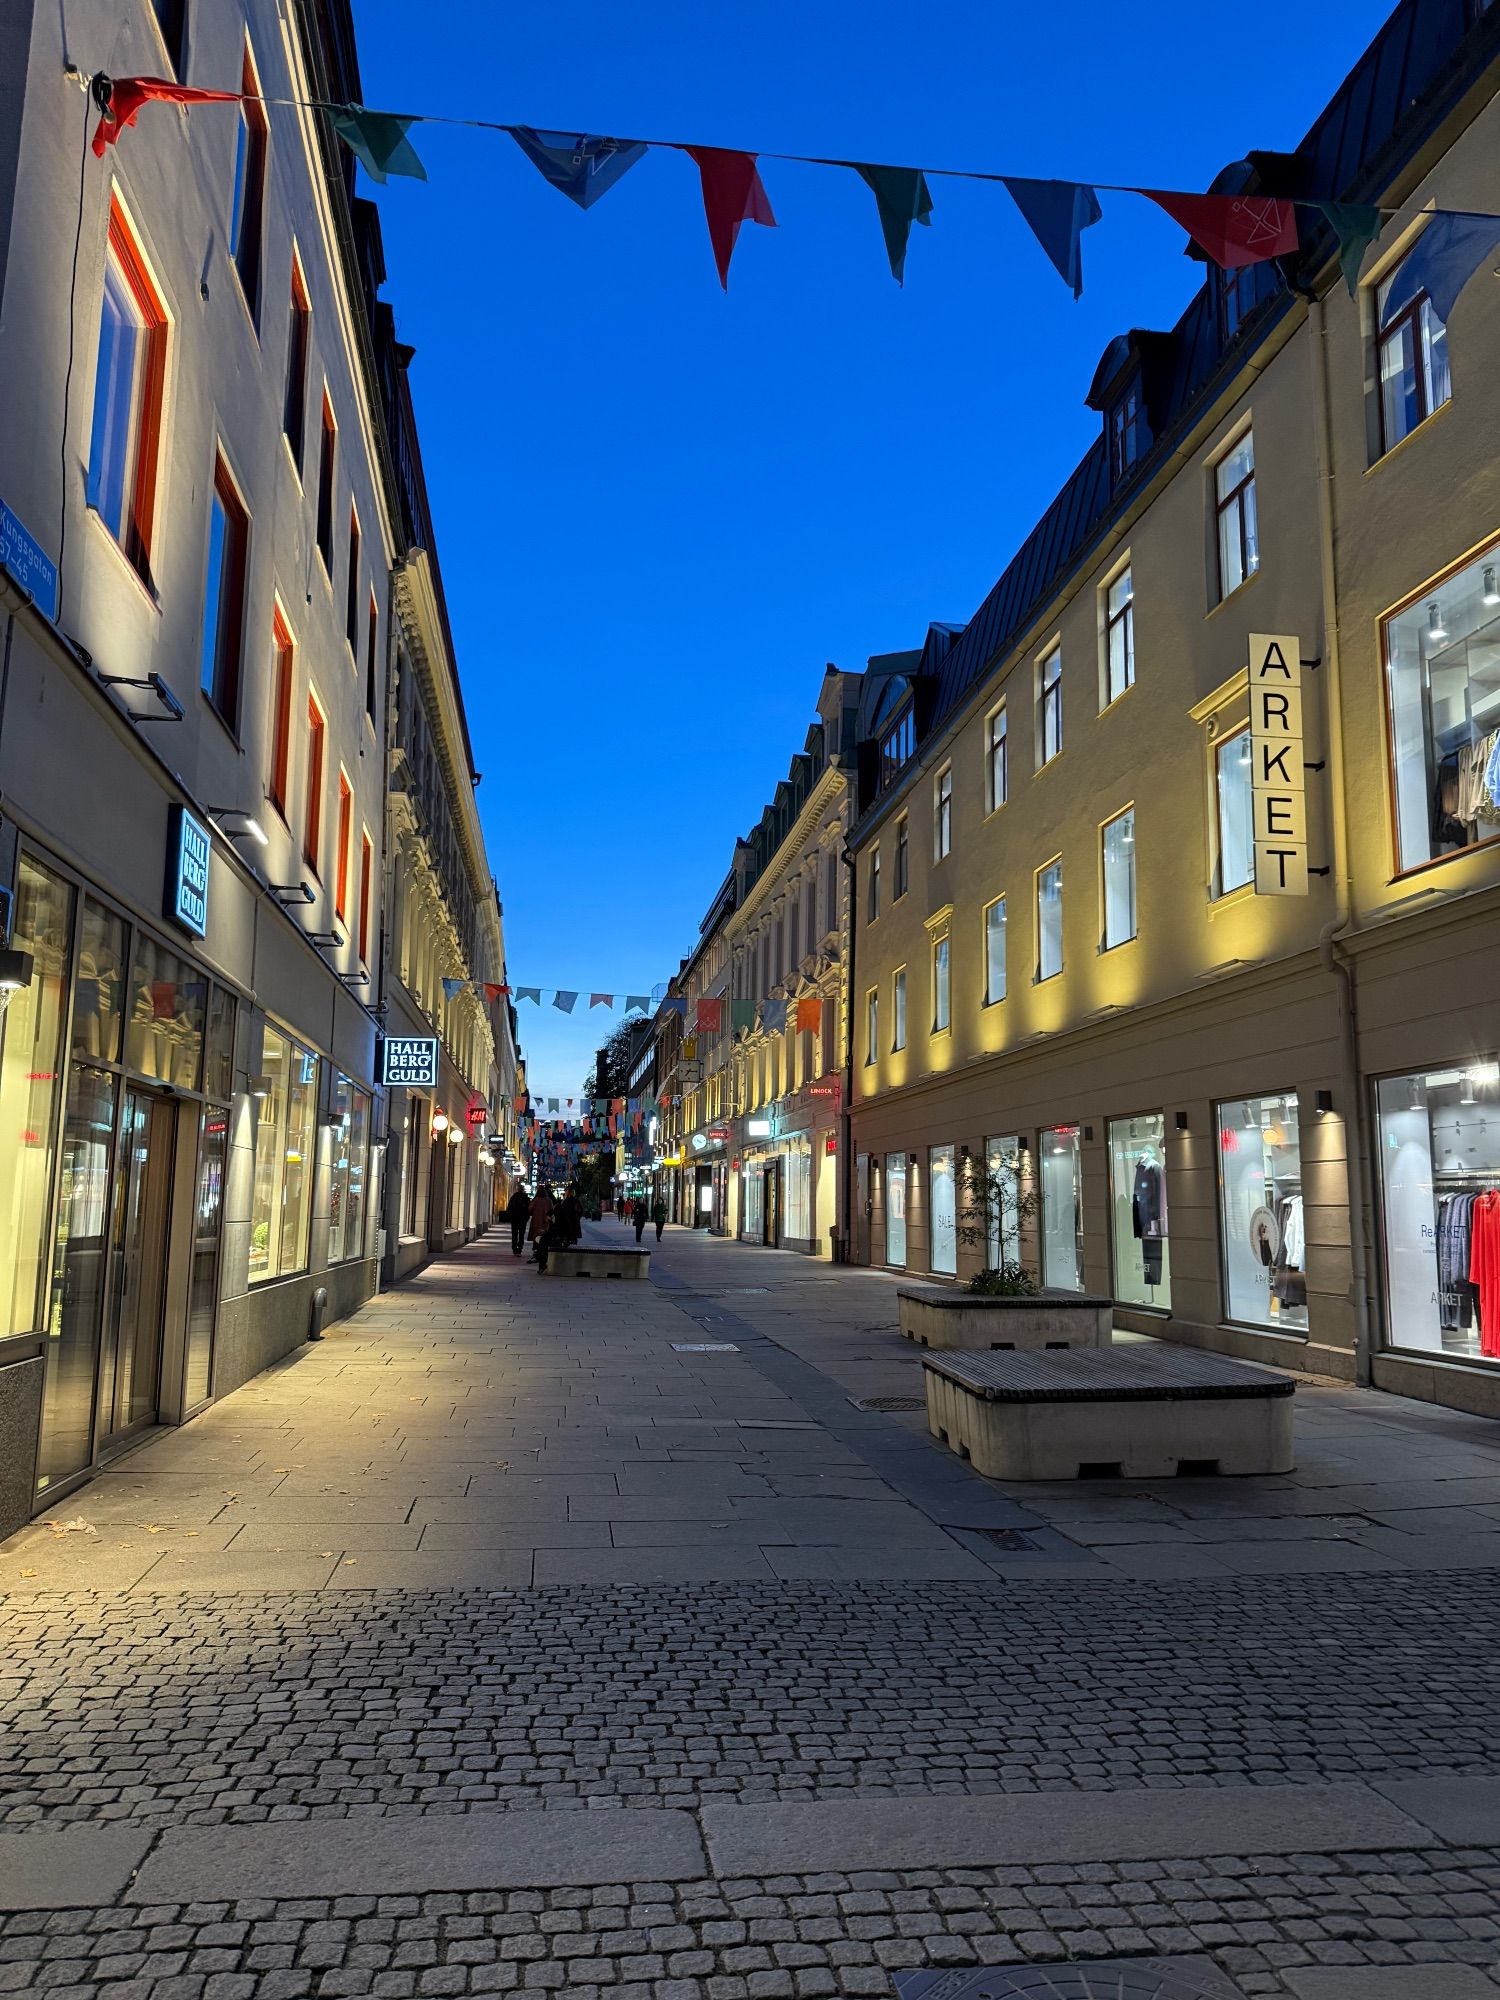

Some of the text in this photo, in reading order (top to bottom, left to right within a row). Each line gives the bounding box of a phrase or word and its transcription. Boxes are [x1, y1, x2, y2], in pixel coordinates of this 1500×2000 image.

[1259, 642, 1297, 888] ARKET
[185, 824, 206, 868] HALL
[181, 885, 204, 923] GULD
[390, 1042, 430, 1055] HALL
[389, 1069, 431, 1082] GULD
[1430, 1291, 1464, 1307] ARKET
